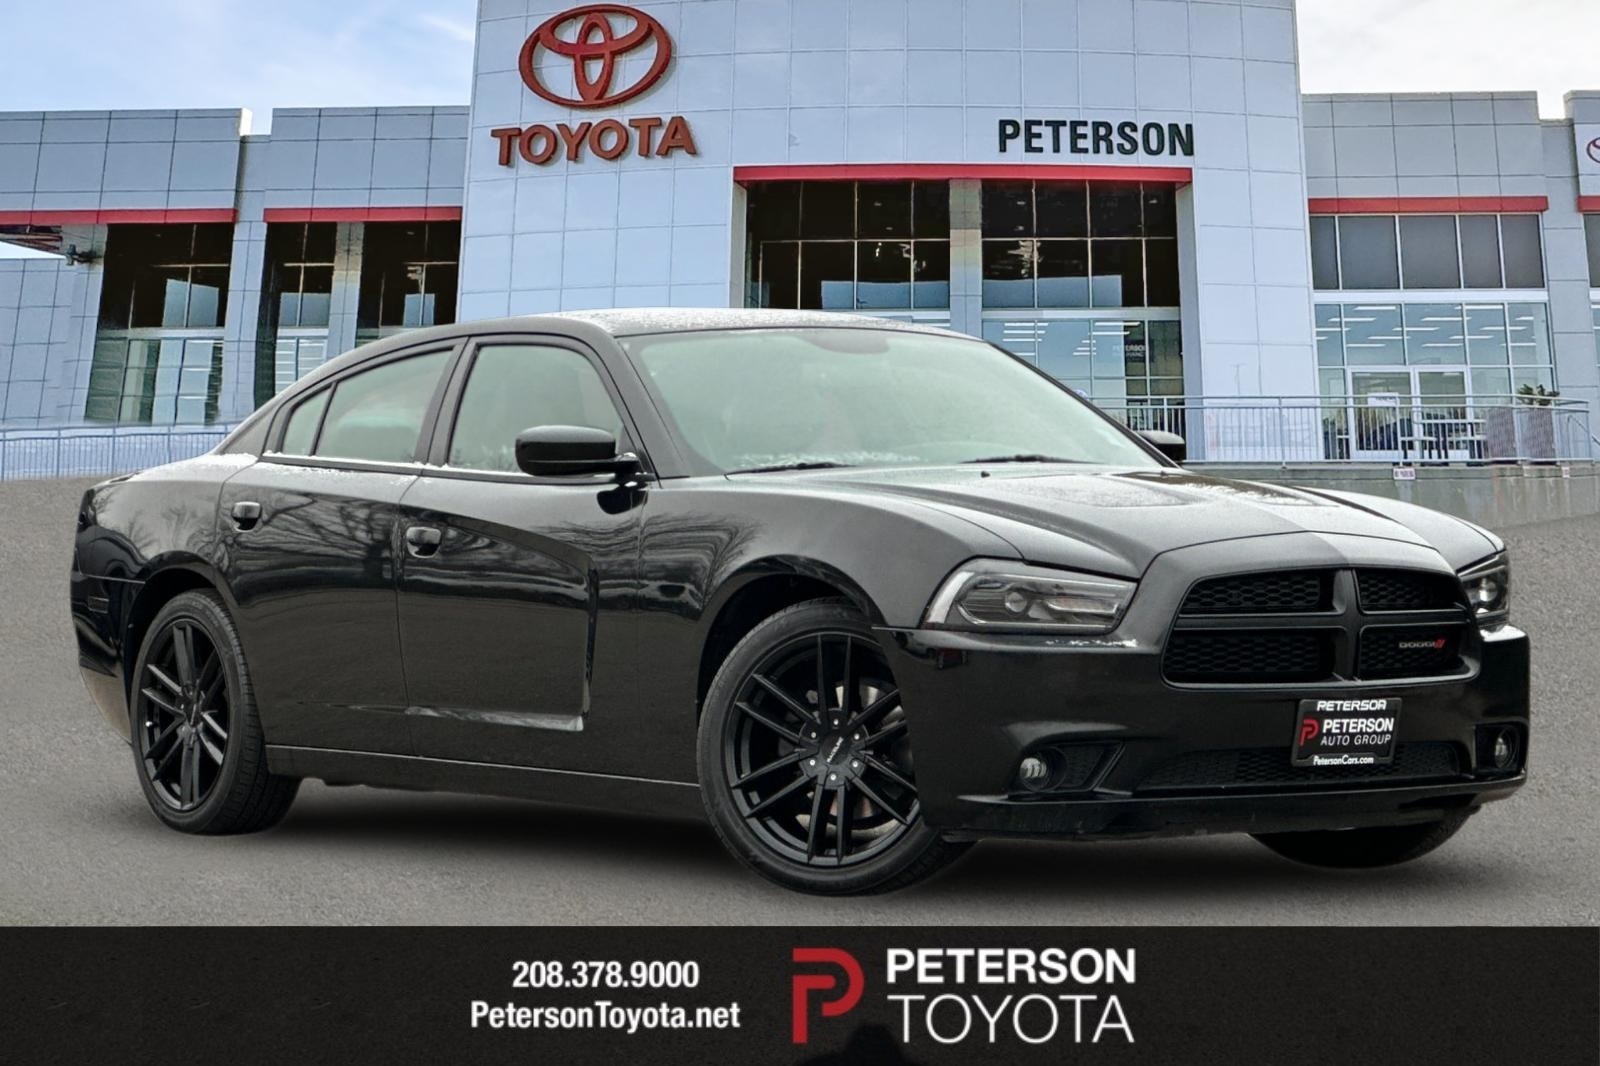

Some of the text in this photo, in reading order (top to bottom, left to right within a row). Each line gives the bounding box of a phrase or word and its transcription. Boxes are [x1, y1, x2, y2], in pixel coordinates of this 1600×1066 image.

[490, 116, 697, 166] TOYOTA
[998, 119, 1195, 157] PETERSON
[1322, 717, 1395, 734] PETERSON
[1320, 733, 1392, 746] AUTO GROUP
